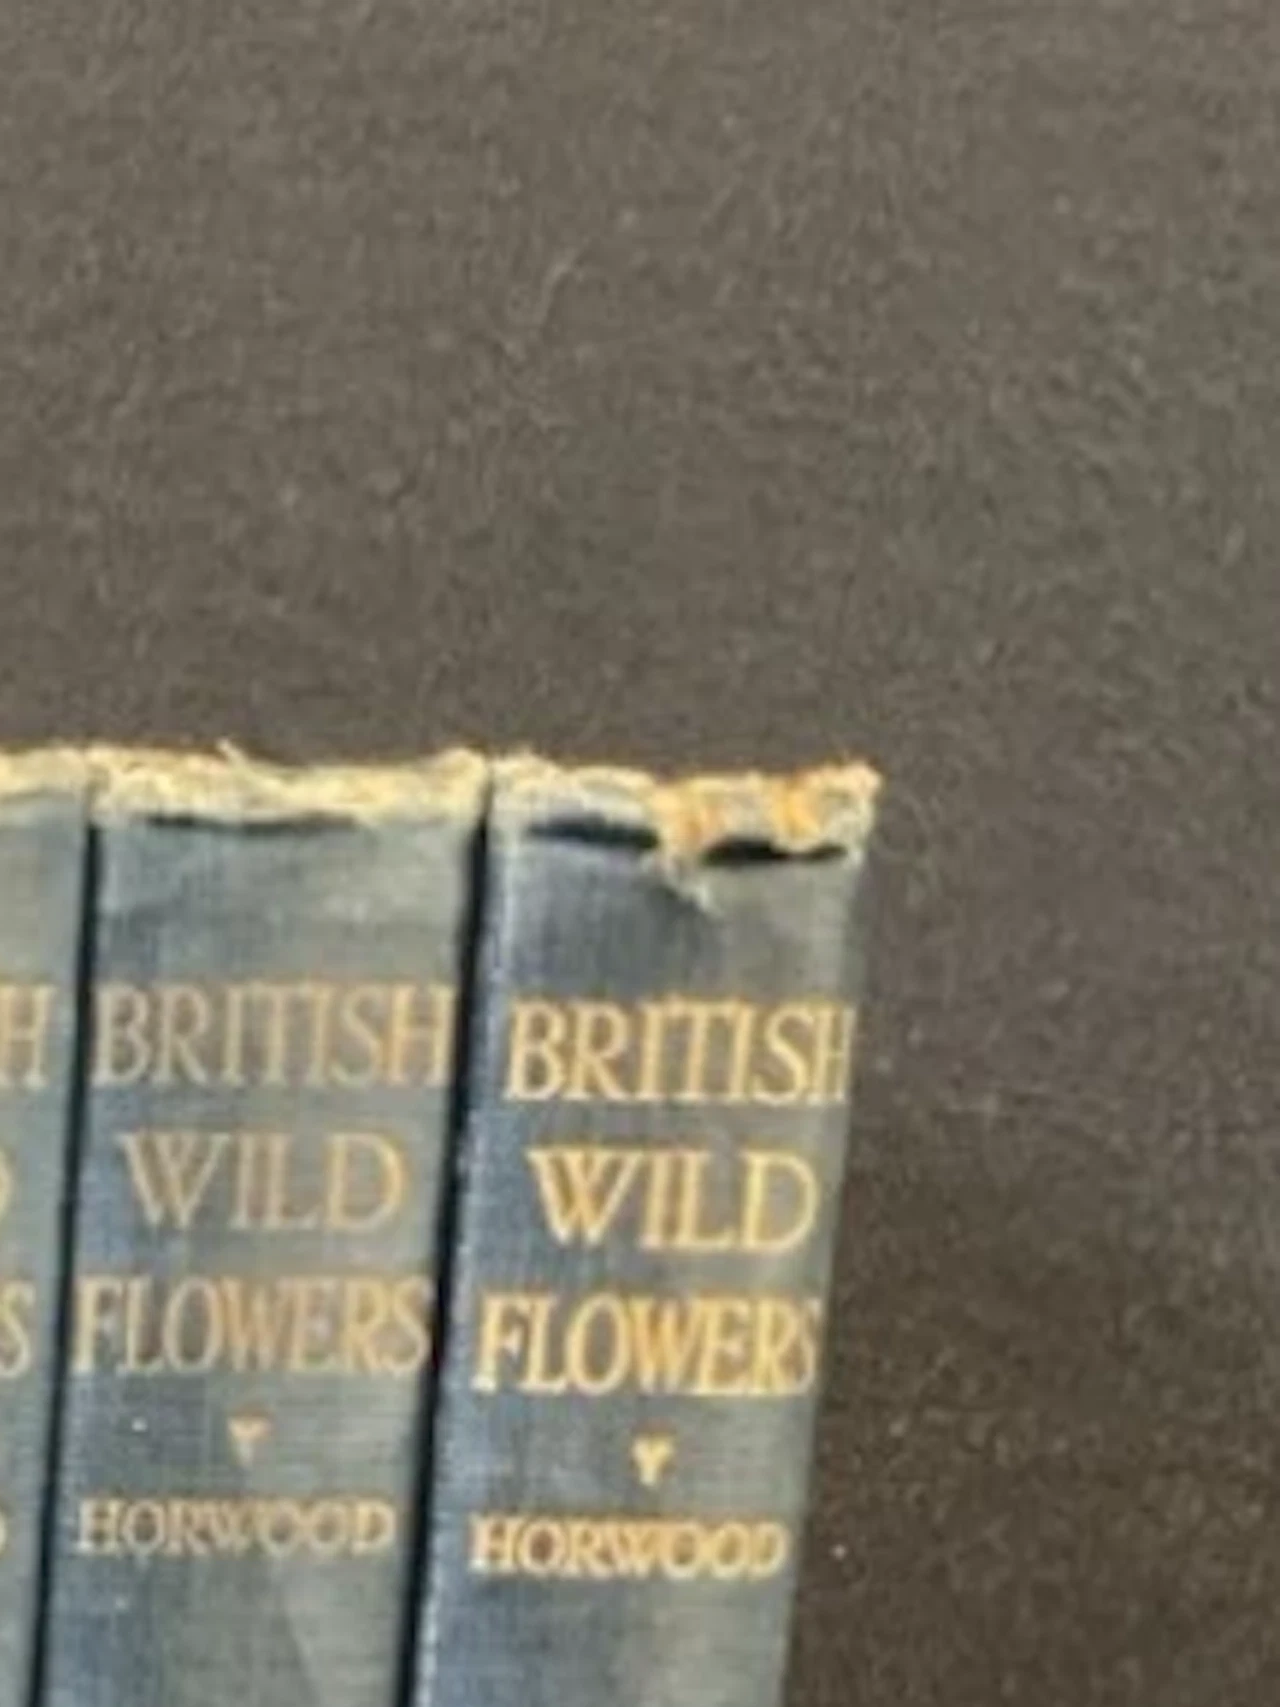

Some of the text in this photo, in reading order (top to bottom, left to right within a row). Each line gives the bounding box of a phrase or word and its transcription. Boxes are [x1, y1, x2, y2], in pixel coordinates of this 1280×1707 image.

[90, 983, 456, 1088] BRITISH
[116, 1130, 410, 1234] WILD
[526, 1146, 824, 1255] WILD
[70, 1276, 432, 1376] FLOWERS
[73, 1498, 397, 1556] HORWOOD
[468, 1515, 791, 1580] HORWOOD
